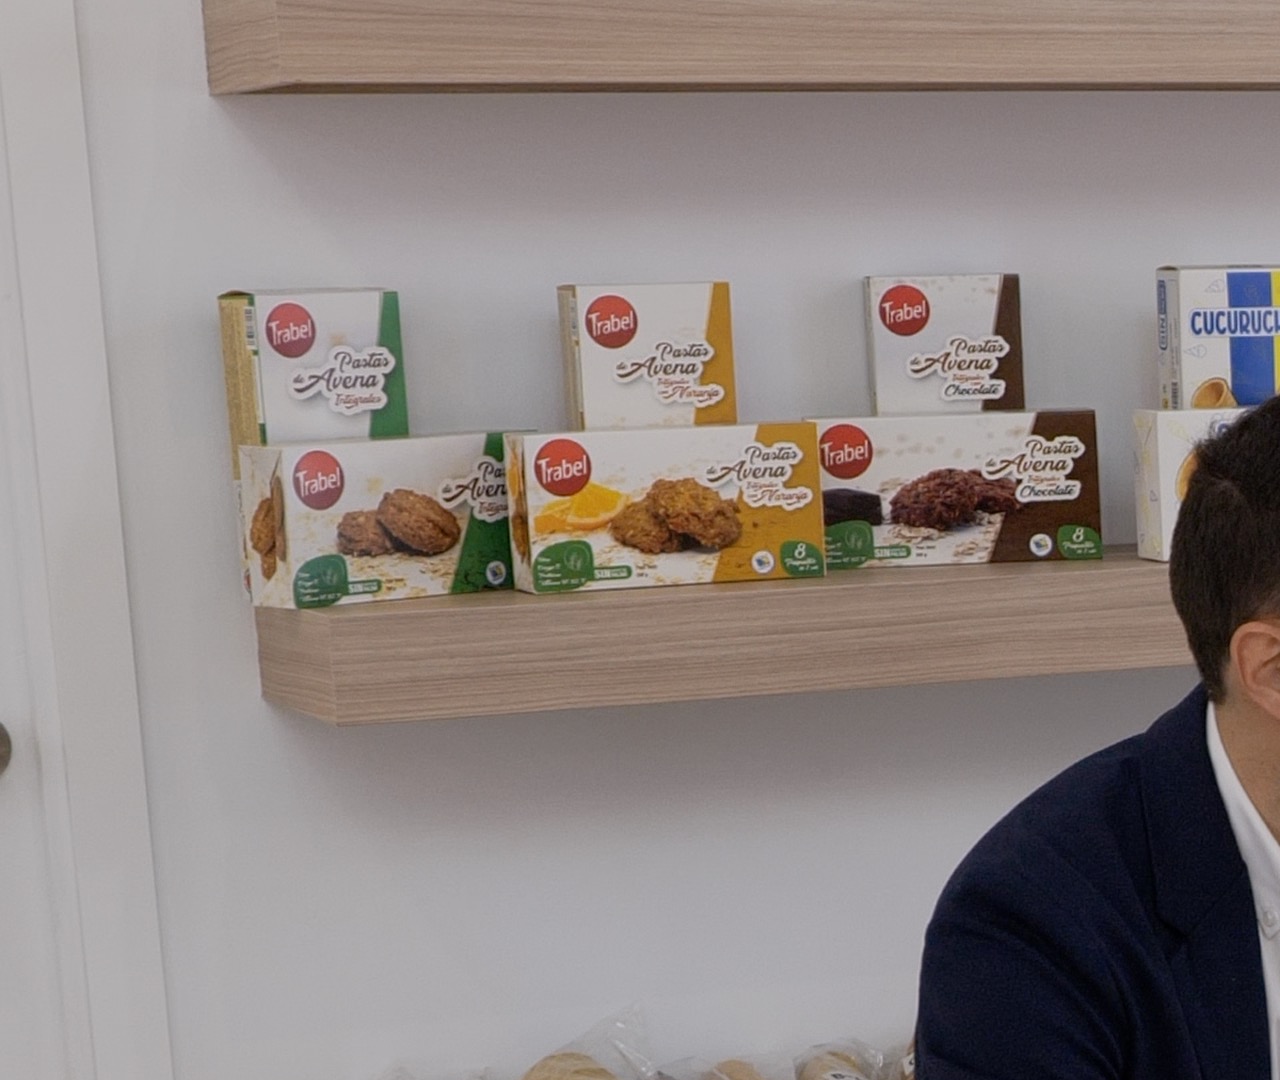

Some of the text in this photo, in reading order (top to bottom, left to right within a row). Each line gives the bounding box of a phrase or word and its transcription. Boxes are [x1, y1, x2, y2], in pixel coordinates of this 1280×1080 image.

[881, 300, 926, 325] Trabel
[268, 319, 312, 346] Trabel
[588, 311, 634, 337] Trabel
[655, 342, 709, 361] Pastas
[949, 338, 1005, 357] Pastas
[334, 351, 391, 373] Pastas
[616, 356, 698, 378] Avena
[910, 352, 993, 373] Avena
[293, 368, 379, 393] Avena
[944, 384, 1000, 397] Chocolate
[745, 446, 798, 465] Pastas
[820, 440, 869, 467] Trabel
[1025, 439, 1081, 459] Pastas
[537, 455, 587, 484] Trabel
[706, 460, 787, 482] Avena
[986, 454, 1067, 475] Avena
[296, 467, 340, 498] Trabel
[442, 478, 507, 503] Aven
[1020, 485, 1077, 498] Chocolate
[1072, 527, 1084, 541] 8
[794, 543, 806, 559] 8
